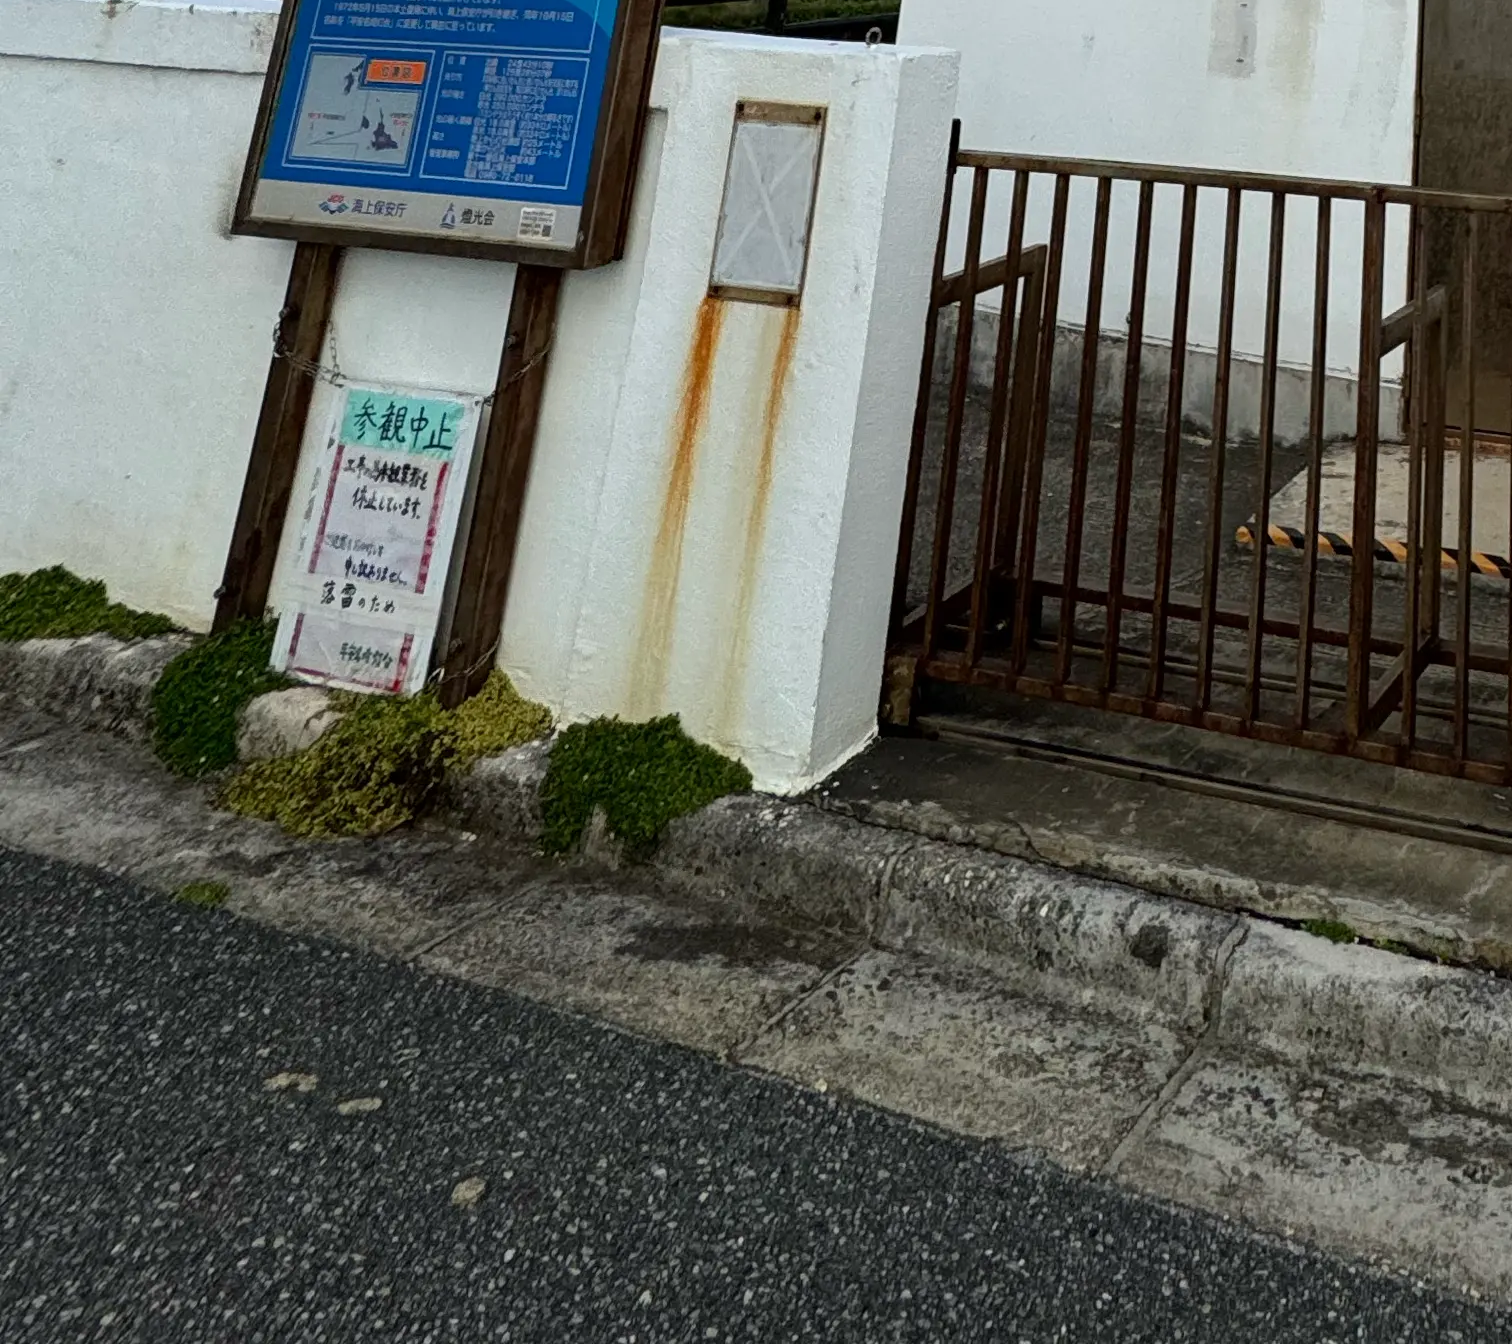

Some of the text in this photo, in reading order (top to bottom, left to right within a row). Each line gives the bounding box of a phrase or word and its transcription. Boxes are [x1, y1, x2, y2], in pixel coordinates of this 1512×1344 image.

[351, 199, 408, 218] 海上保安庁
[354, 397, 452, 450] 参観中止
[320, 580, 396, 614] 落雷のため
